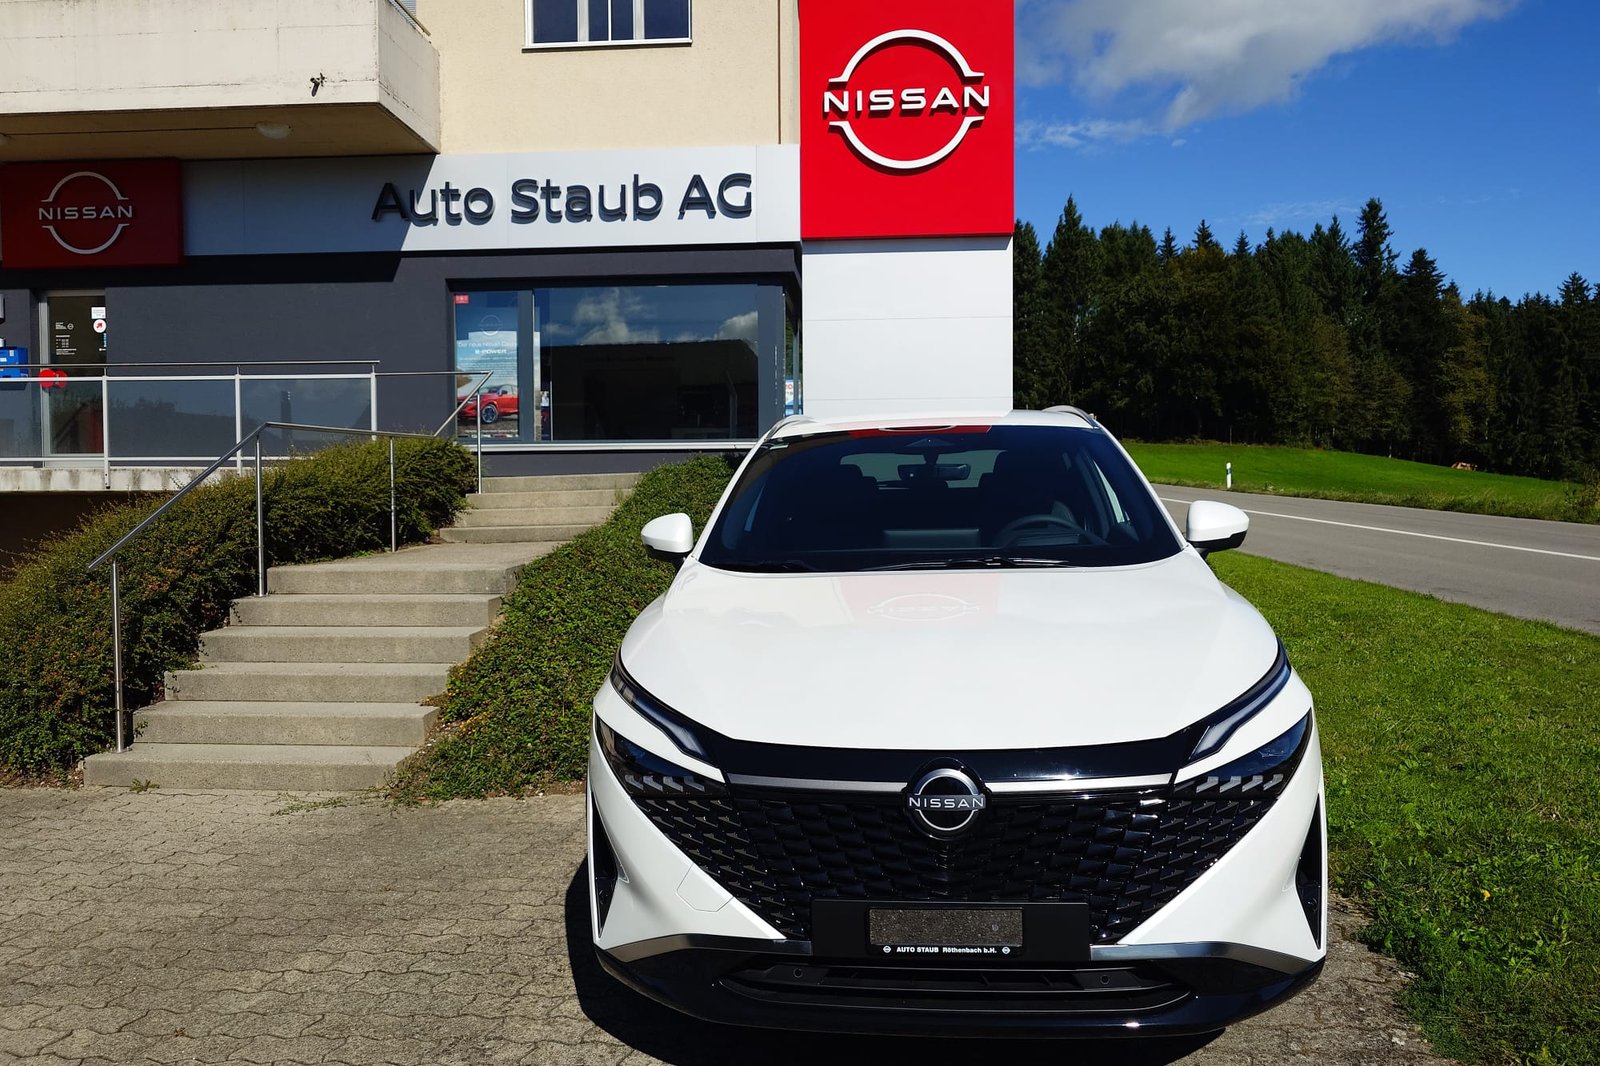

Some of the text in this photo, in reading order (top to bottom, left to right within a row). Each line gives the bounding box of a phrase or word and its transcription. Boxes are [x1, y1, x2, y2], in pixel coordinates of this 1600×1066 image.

[823, 86, 990, 113] NISSAN
[372, 172, 752, 226] Auto Staub AG
[38, 205, 133, 220] NISSAN
[908, 797, 985, 808] NISSAN
